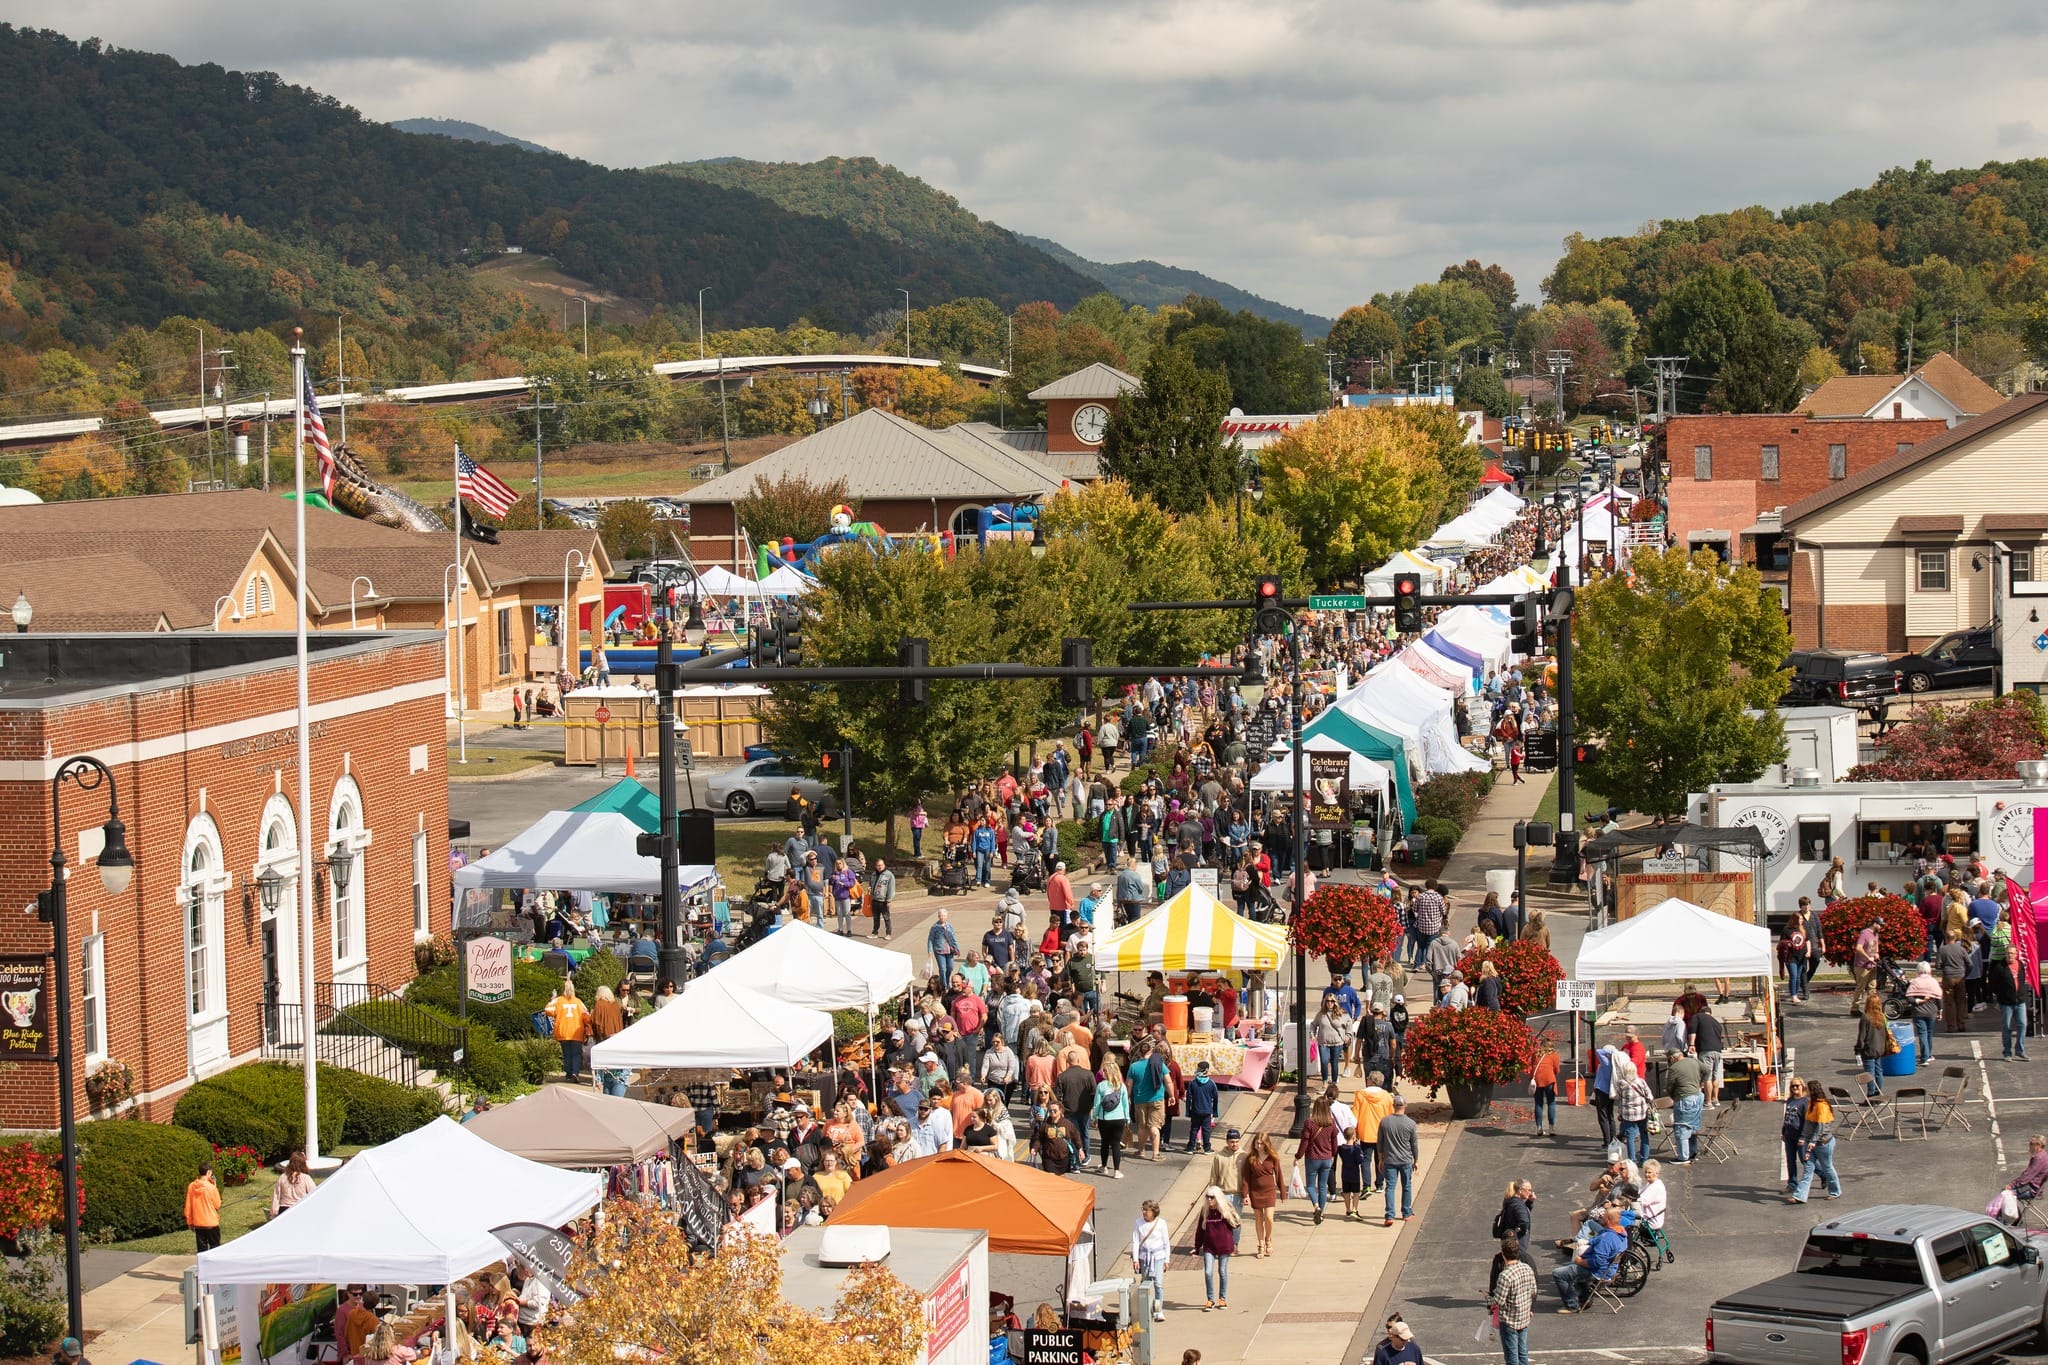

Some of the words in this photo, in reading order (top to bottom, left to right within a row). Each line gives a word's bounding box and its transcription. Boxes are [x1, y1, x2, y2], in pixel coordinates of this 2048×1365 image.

[1315, 598, 1348, 607] Tucker
[596, 710, 609, 718] STOP
[682, 754, 690, 766] 5
[1311, 757, 1349, 767] Celebrate
[1733, 810, 1757, 829] UNTIE
[1997, 807, 2022, 833] AUNTIE
[1625, 873, 1678, 885] HIGHLANDS
[1690, 873, 1705, 883] AXE
[1713, 873, 1749, 883] COMPANY
[472, 943, 505, 964] Plant
[0, 964, 46, 974] Celebrate
[470, 961, 509, 983] Palace
[13, 974, 33, 985] Years
[35, 974, 42, 986] of
[1558, 982, 1567, 990] AXE
[469, 991, 492, 1001] FLOWERS
[498, 991, 511, 999] GIFTS
[1568, 990, 1593, 998] THROWS
[1571, 999, 1580, 1009] $5
[562, 1003, 577, 1018] T
[3, 1028, 20, 1040] Blue
[21, 1029, 44, 1042] Ridge
[9, 1039, 37, 1052] Pottery
[1032, 1335, 1074, 1347] PUBLIC
[1028, 1351, 1079, 1364] PARKING
